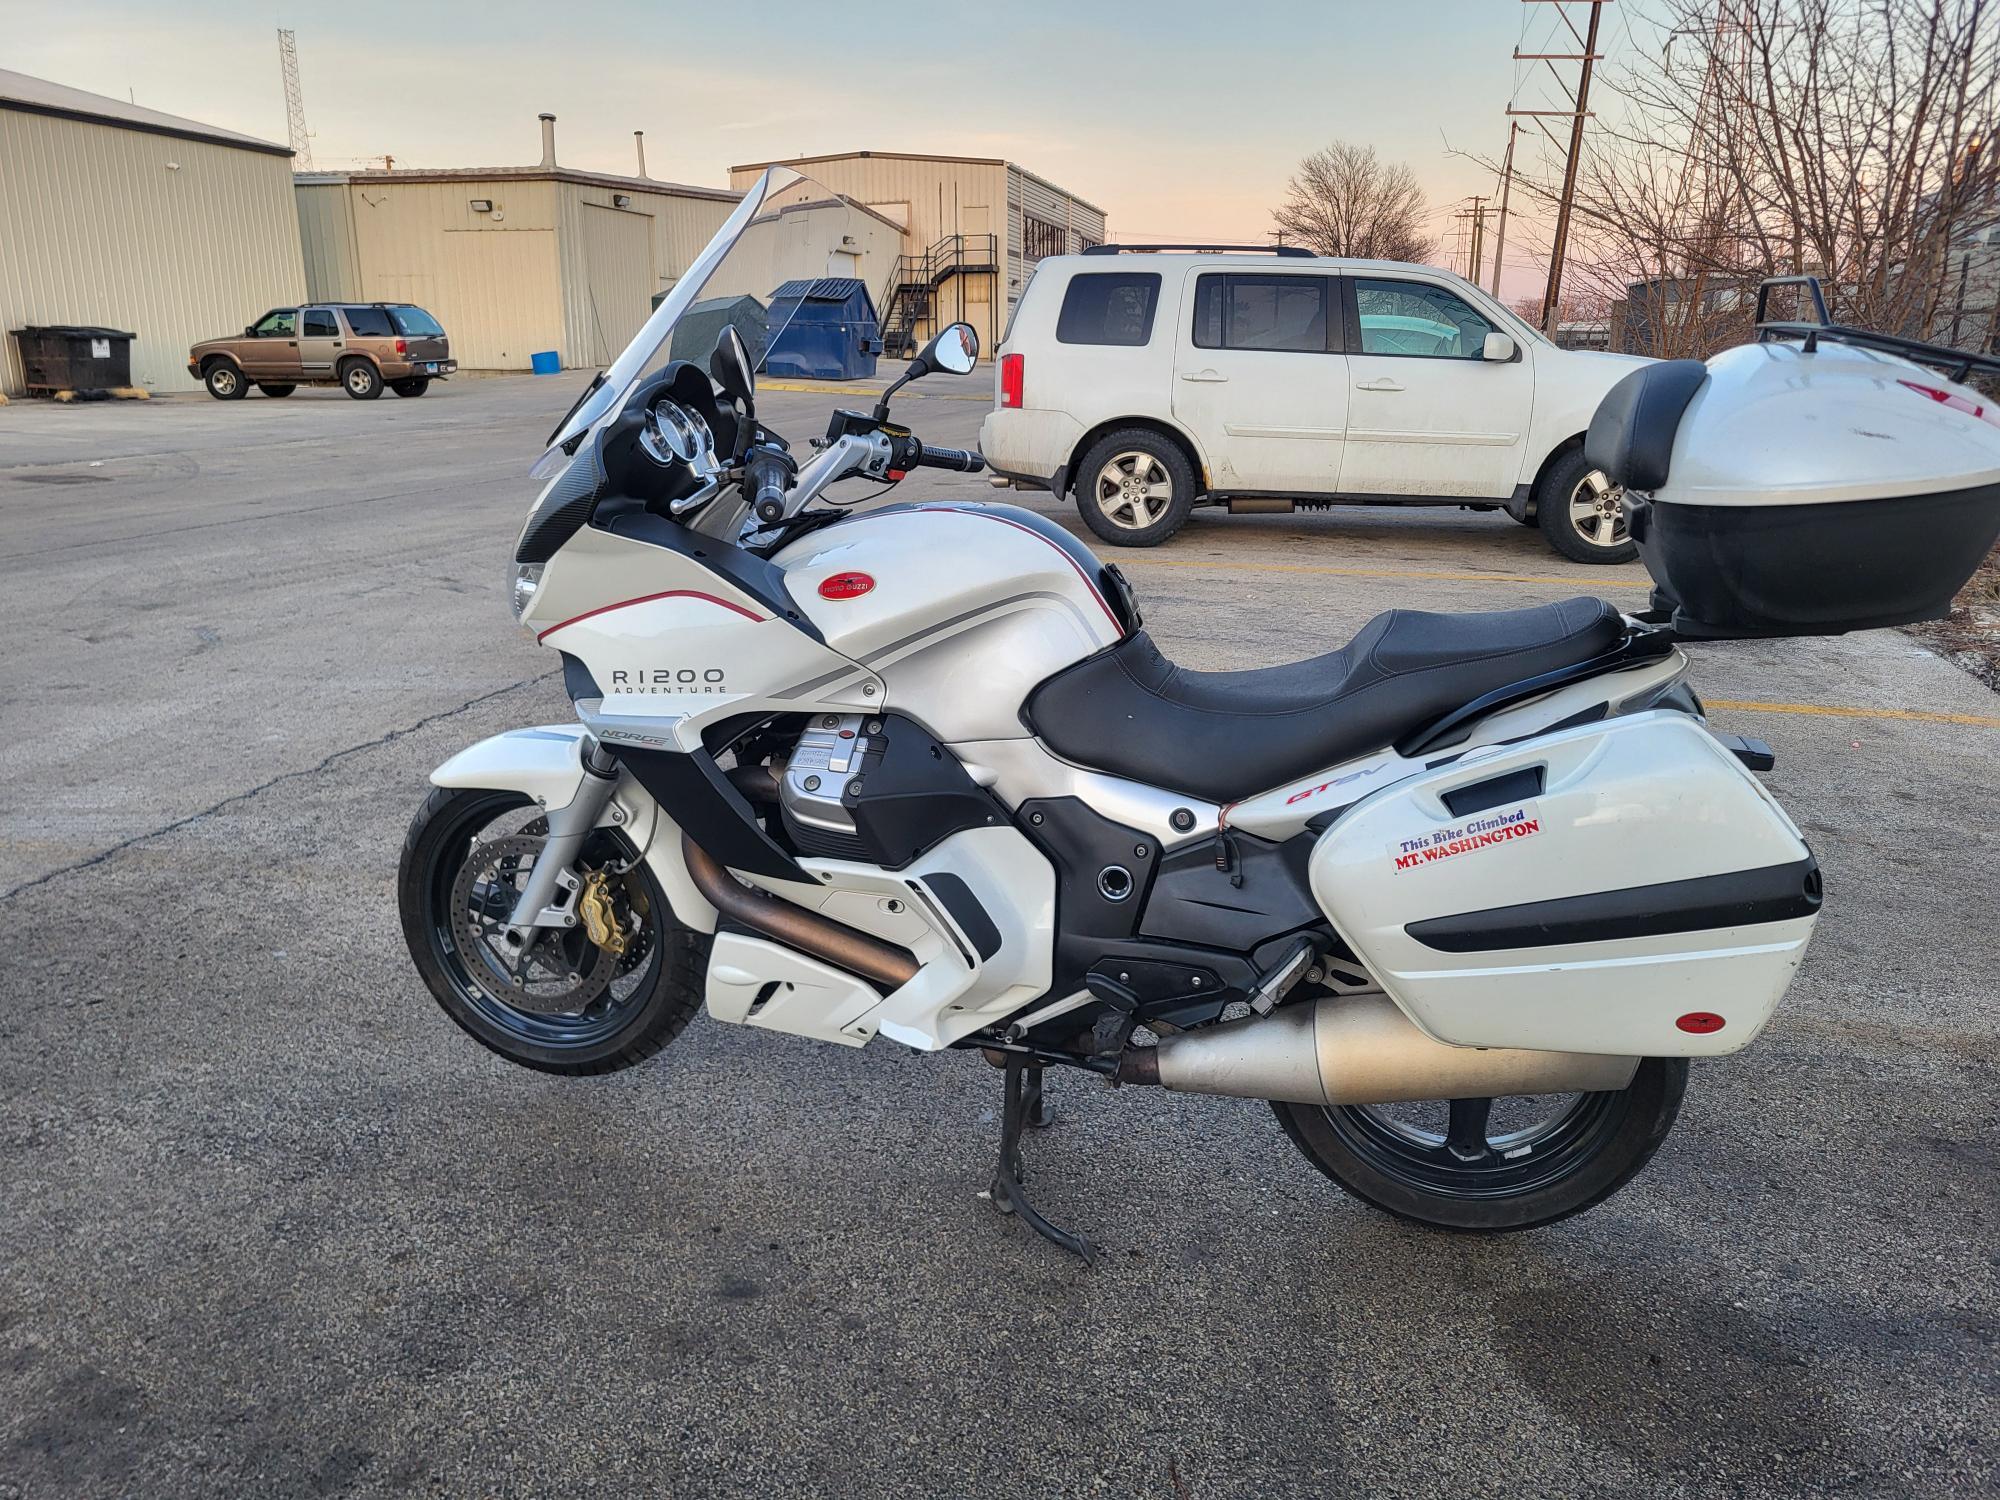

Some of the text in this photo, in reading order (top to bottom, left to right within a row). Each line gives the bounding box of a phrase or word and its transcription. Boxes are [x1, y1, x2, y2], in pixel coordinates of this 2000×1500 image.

[846, 583, 868, 591] GUZZI
[612, 668, 725, 684] R1200
[614, 686, 726, 694] ADVENTURE
[601, 729, 671, 745] NORGE
[1400, 809, 1525, 853] This Bike Climbed
[1422, 819, 1540, 862] WASHINGTON
